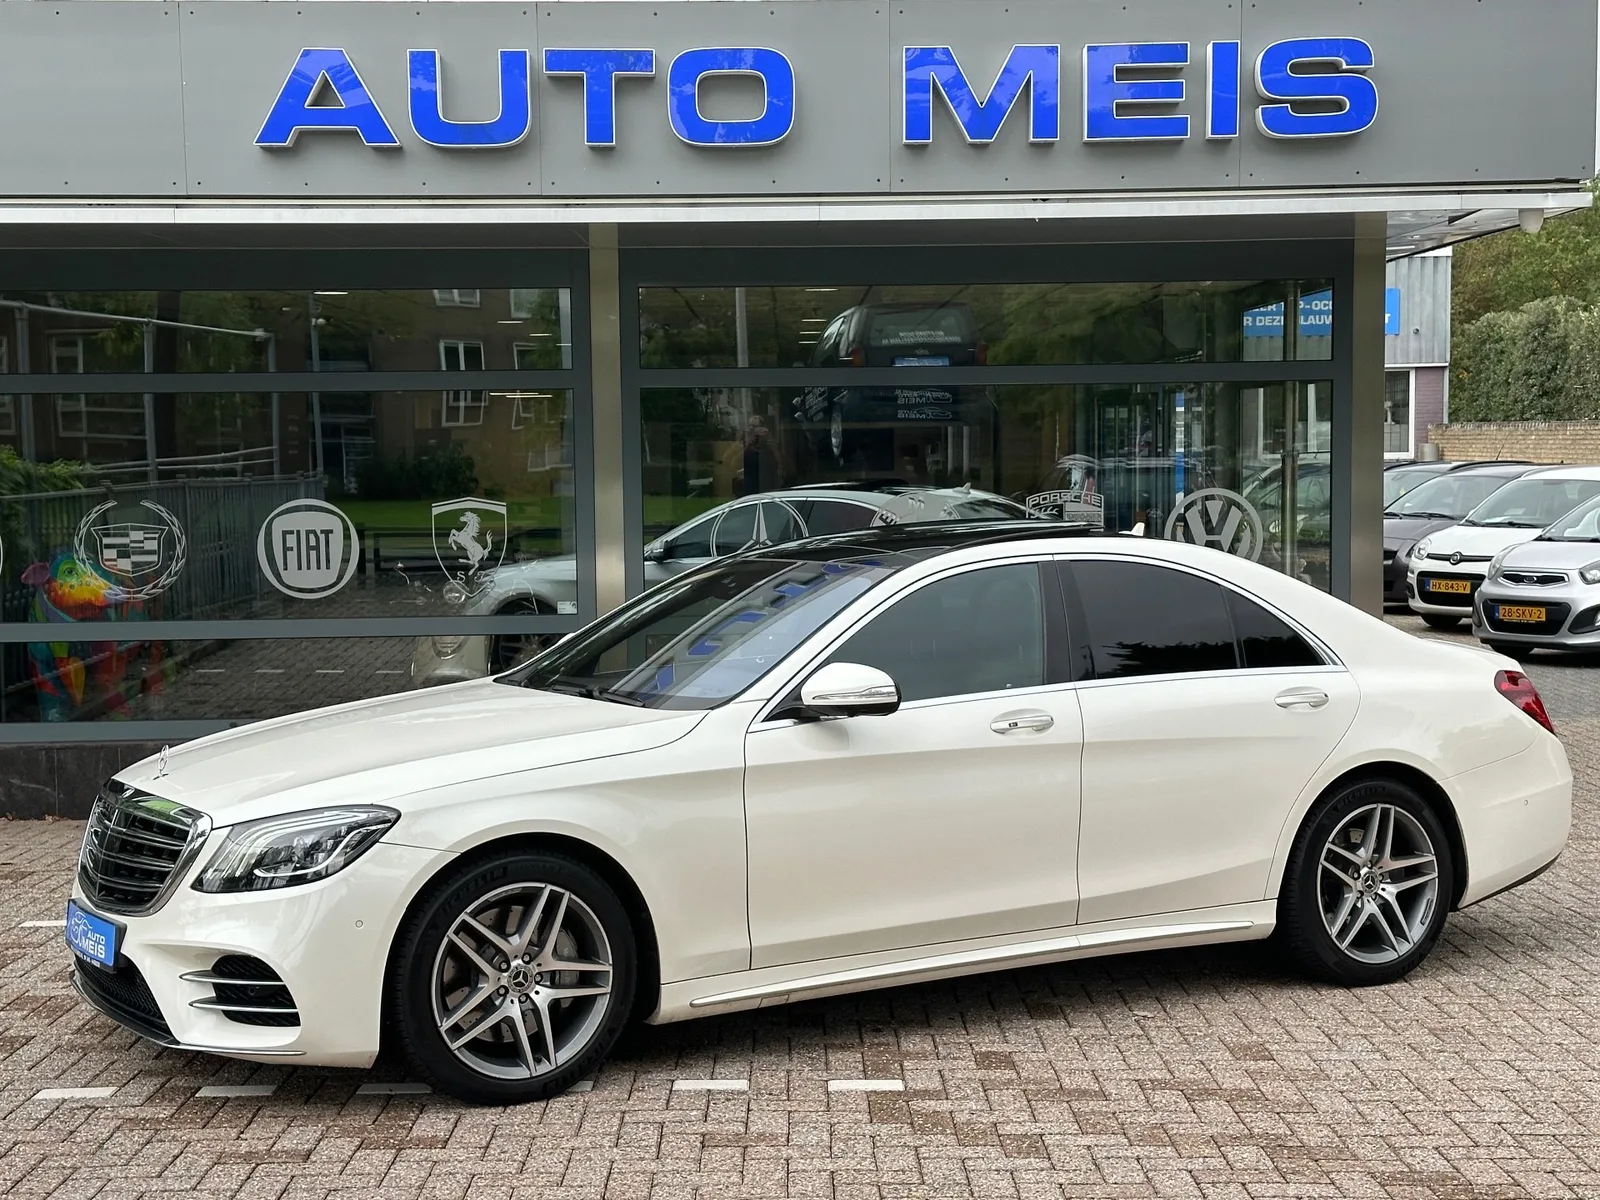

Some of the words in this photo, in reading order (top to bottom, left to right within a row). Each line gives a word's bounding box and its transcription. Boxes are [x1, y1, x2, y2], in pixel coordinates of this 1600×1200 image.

[253, 46, 796, 148] AUTO
[902, 36, 1379, 145] MEIS
[1029, 492, 1101, 508] PORSCHE
[281, 528, 334, 571] FIAT
[1431, 582, 1468, 592] HX-843-V
[1501, 607, 1543, 619] 28-SKV-2
[87, 930, 106, 945] AUTO
[82, 936, 106, 959] MEIS
